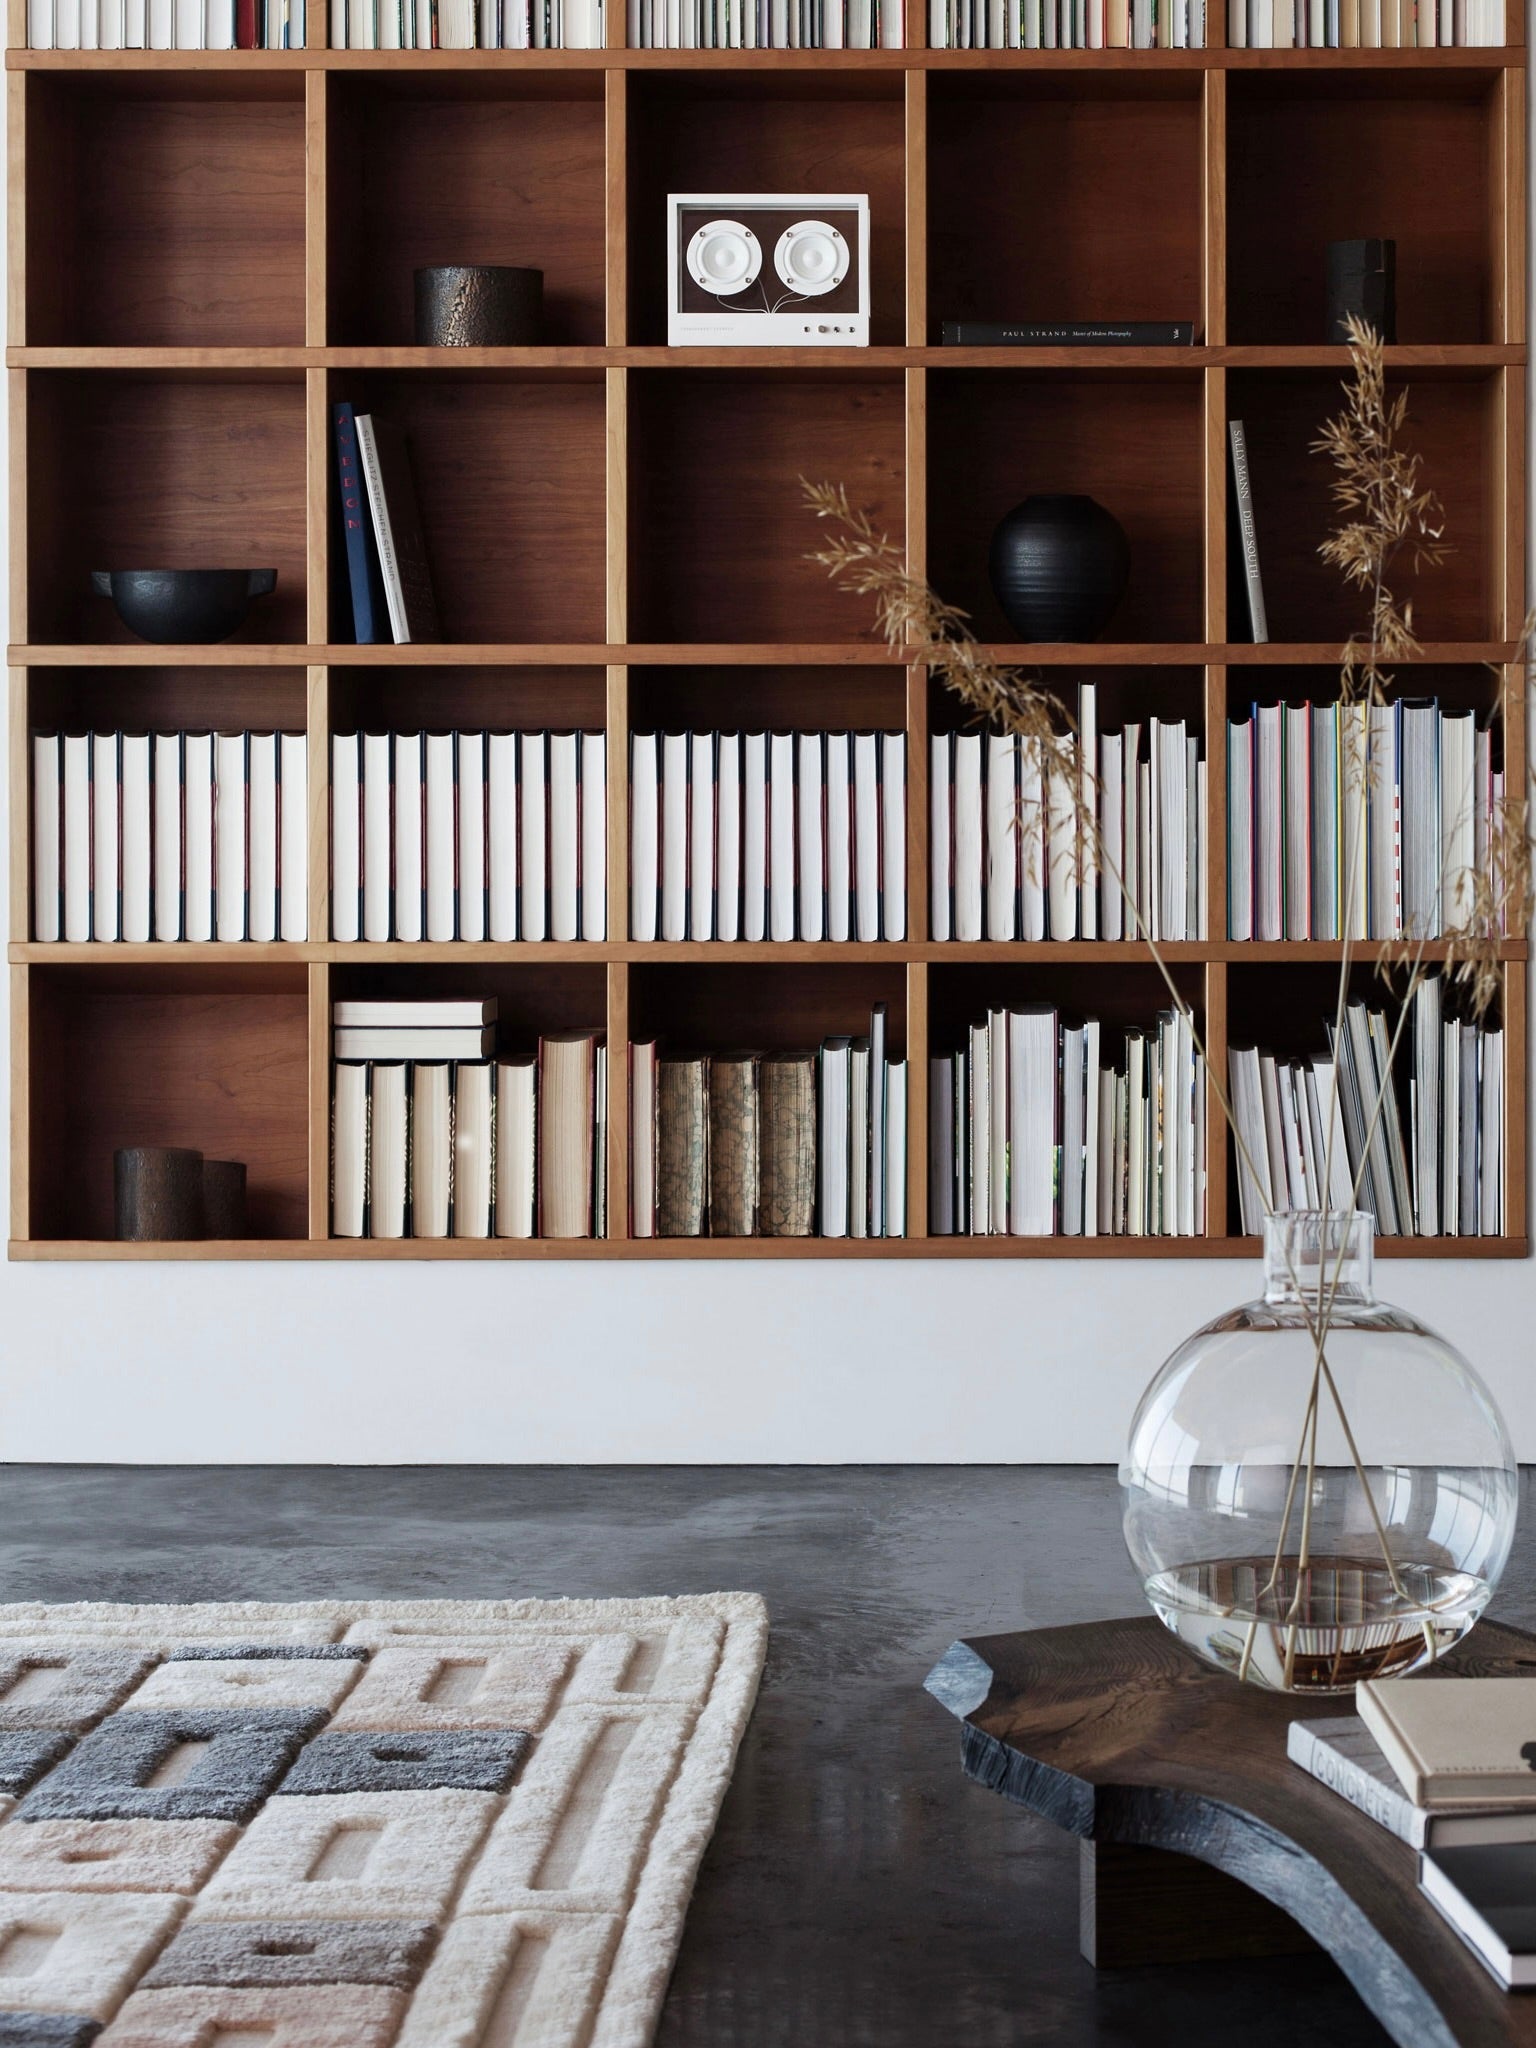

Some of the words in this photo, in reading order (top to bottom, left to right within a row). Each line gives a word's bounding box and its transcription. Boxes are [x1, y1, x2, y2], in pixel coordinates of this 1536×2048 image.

[1233, 429, 1245, 462] SALLY
[337, 415, 361, 529] AVEDON
[1237, 464, 1250, 499] MANN
[362, 429, 378, 481] STIEGLITZ
[371, 483, 387, 535] STEICHEN
[381, 538, 396, 581] STRAND
[1242, 510, 1254, 537] DEEP
[1246, 539, 1259, 579] SOUTH
[1316, 1751, 1392, 1826] CONCRETE
